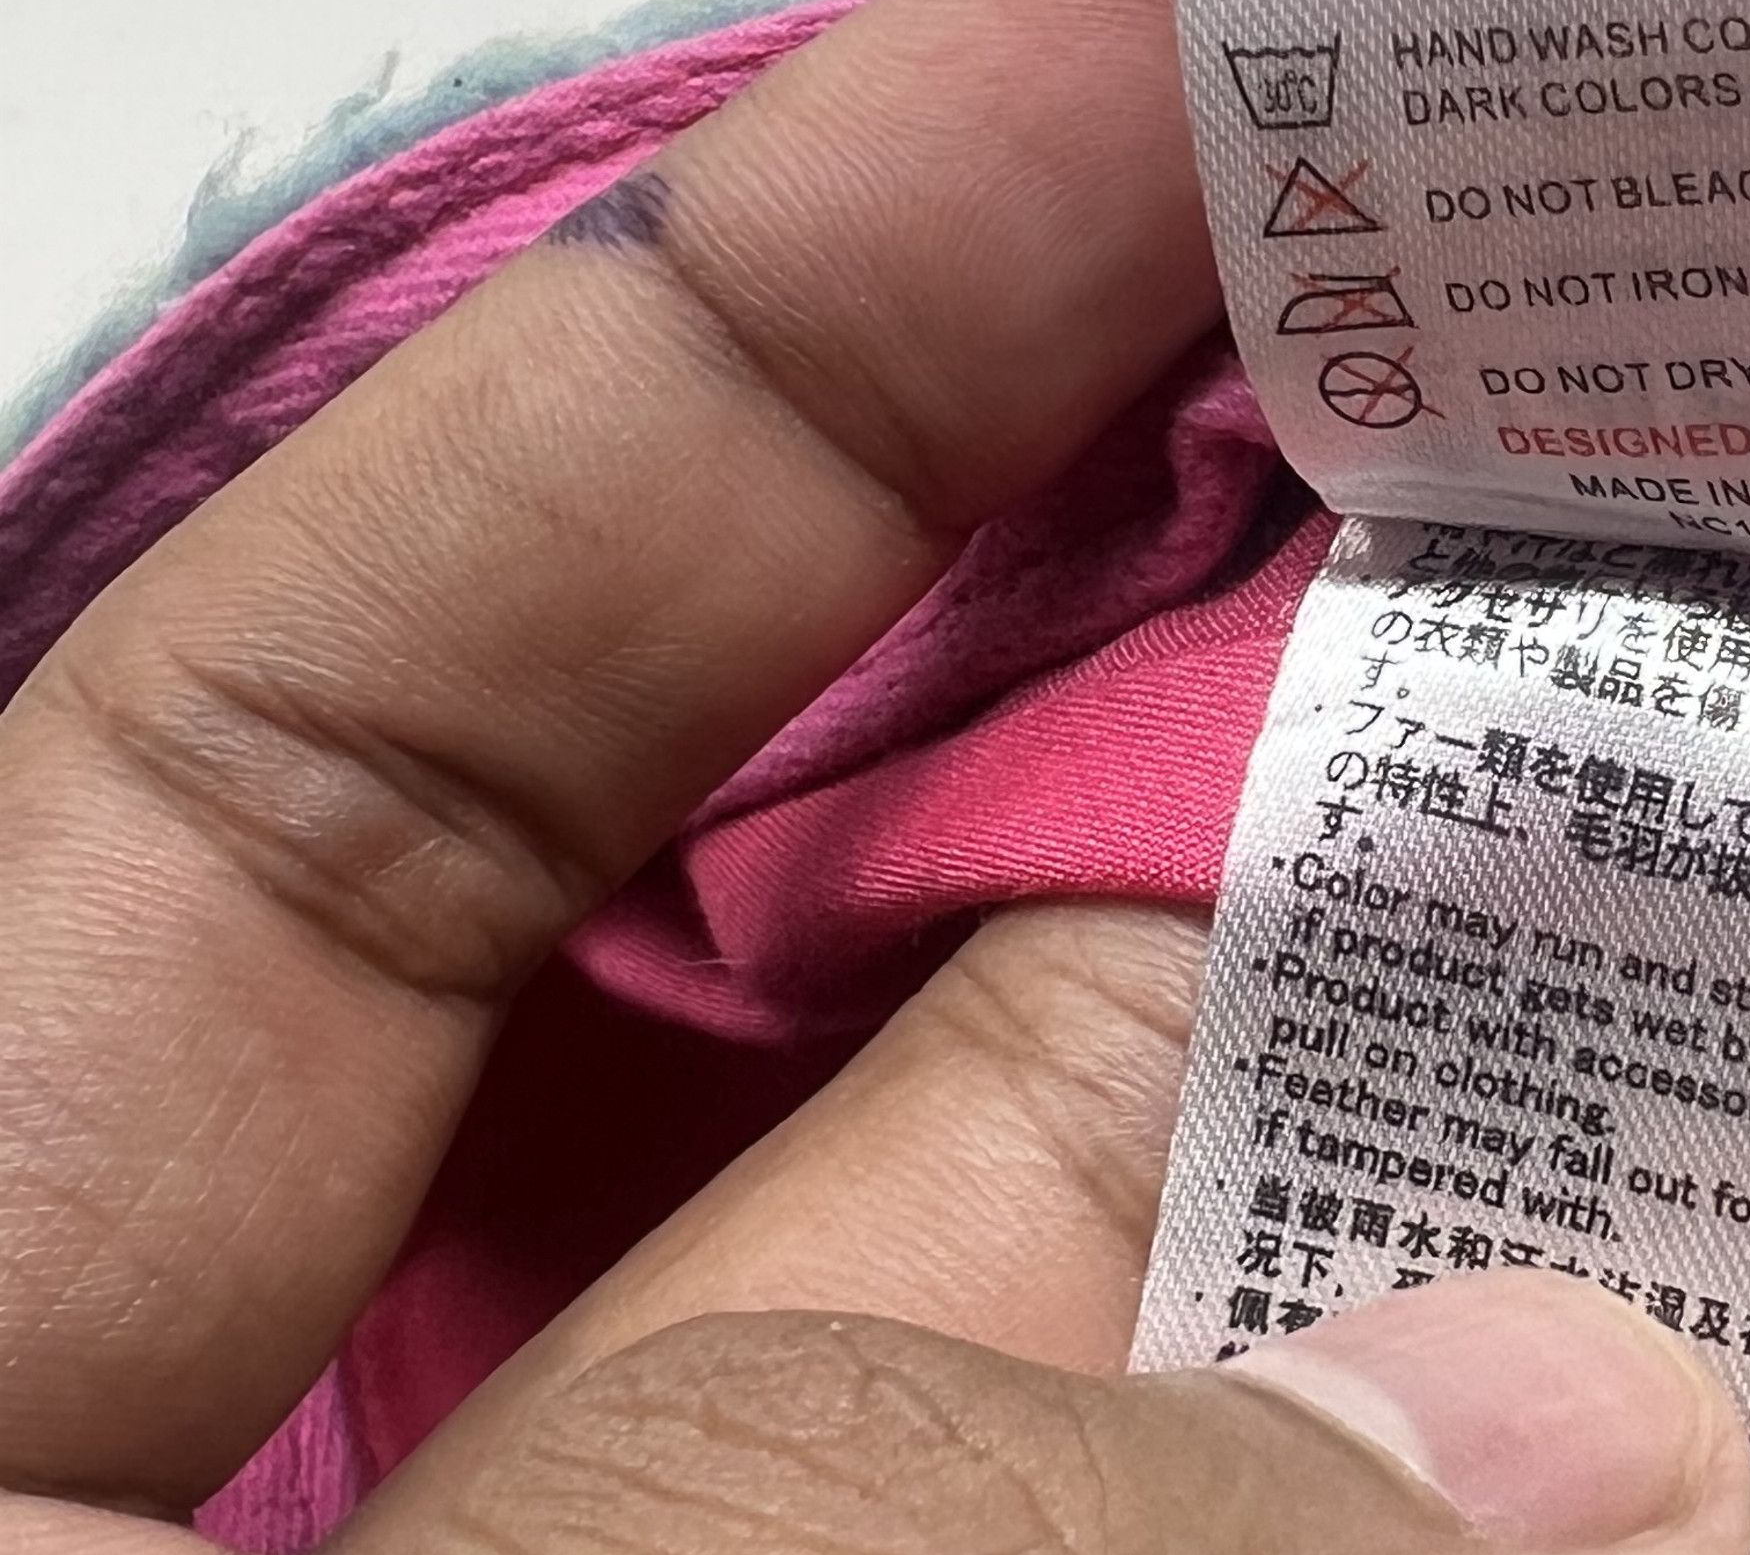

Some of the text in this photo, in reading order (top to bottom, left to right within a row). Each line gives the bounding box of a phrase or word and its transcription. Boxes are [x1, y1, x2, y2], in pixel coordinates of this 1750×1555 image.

[1391, 26, 1518, 71] HAND
[1528, 18, 1668, 64] WASH
[1403, 85, 1528, 127] DARK
[1539, 71, 1742, 116] COLORS
[1425, 184, 1492, 224] DO
[1503, 178, 1599, 218] NOT
[1445, 265, 1750, 313] DO NOT IRON
[1479, 366, 1546, 396] DO
[1557, 361, 1650, 394] NOT
[1568, 472, 1700, 507] MADE
[1426, 898, 1519, 952] may
[1532, 929, 1604, 972] run
[1619, 952, 1698, 996] and
[1289, 903, 1326, 944] if
[1332, 928, 1506, 997] product
[1519, 978, 1615, 1027] gets
[1633, 1009, 1709, 1053] wet
[1468, 1013, 1555, 1064] with
[1268, 1014, 1616, 1138] pull on clothing.
[1253, 1104, 1622, 1244] if tampered with.
[1441, 1111, 1538, 1166] may
[1549, 1133, 1614, 1186] fall
[1627, 1165, 1699, 1211] out
